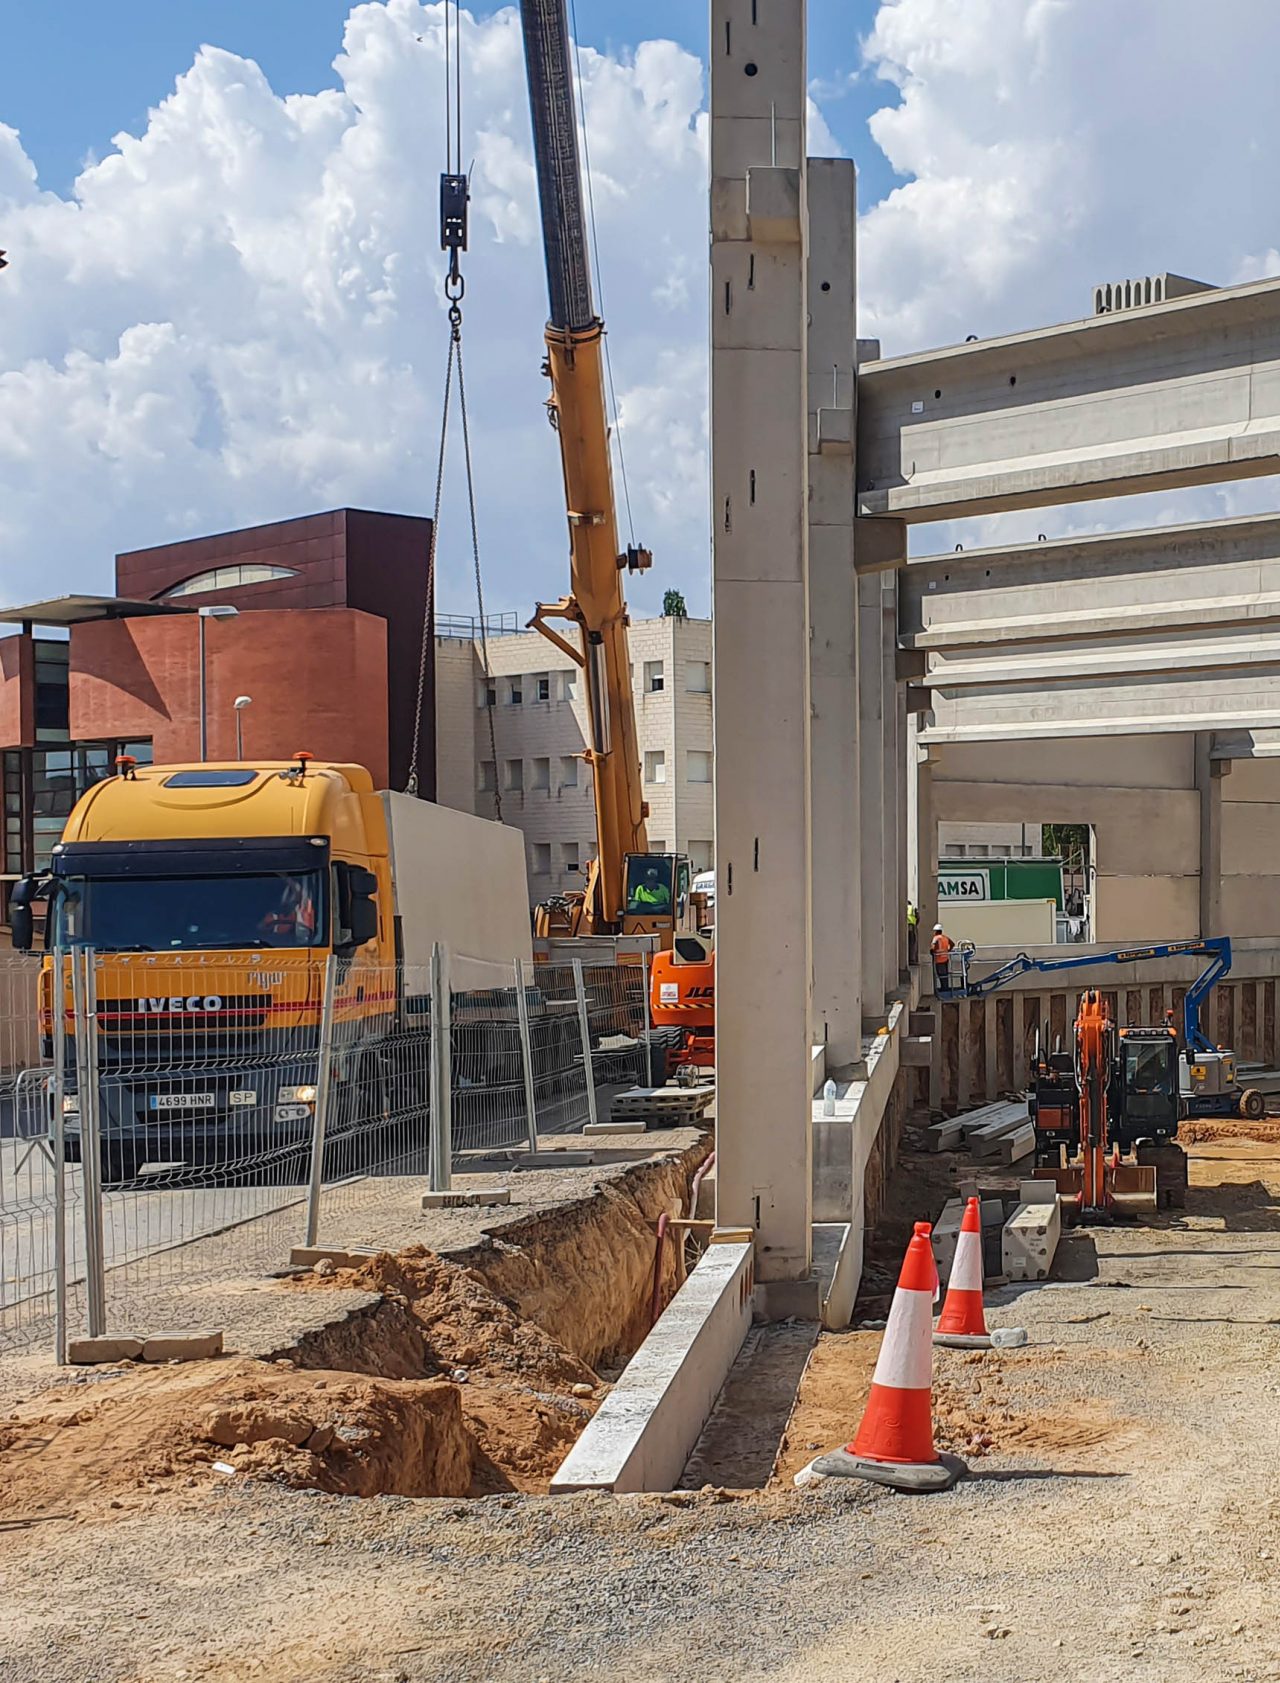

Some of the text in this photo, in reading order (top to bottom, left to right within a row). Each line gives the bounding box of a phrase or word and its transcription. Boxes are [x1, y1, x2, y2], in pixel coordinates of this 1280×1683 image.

[138, 995, 221, 1014] IVECO
[158, 1094, 212, 1106] 4699 HNR
